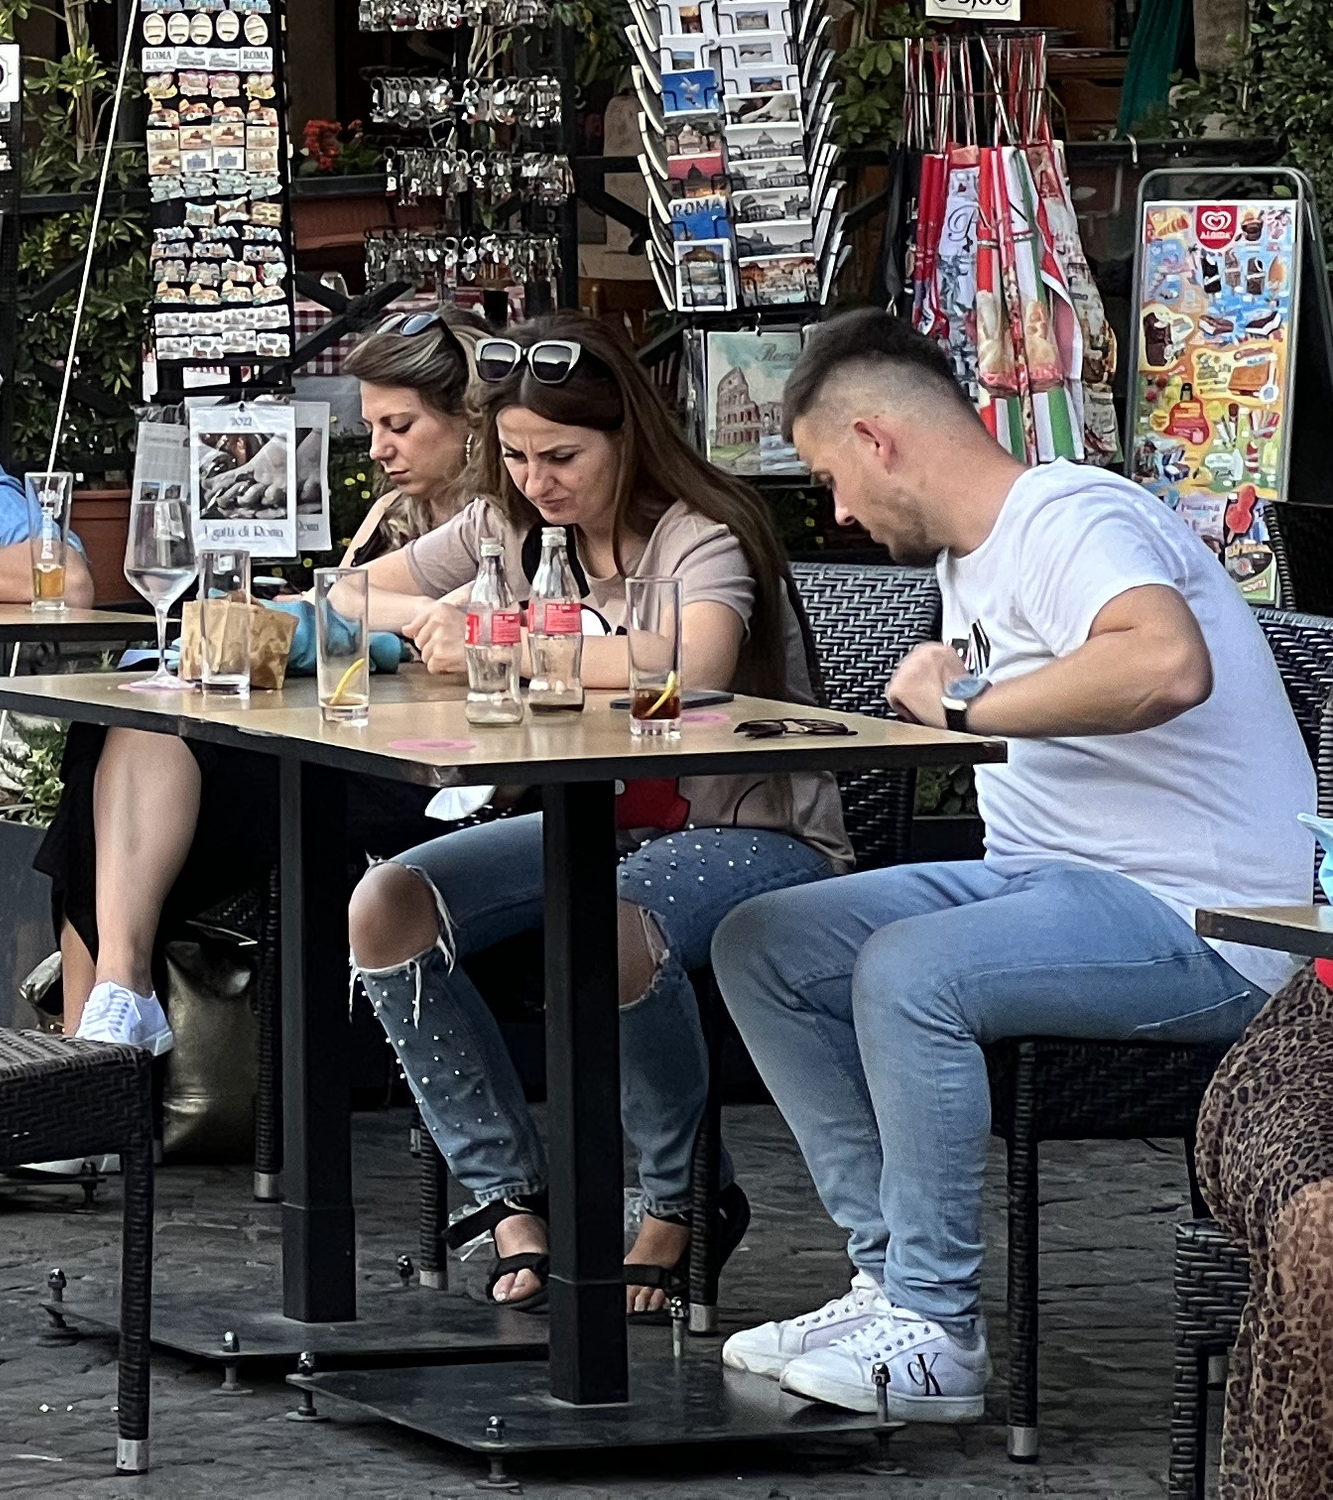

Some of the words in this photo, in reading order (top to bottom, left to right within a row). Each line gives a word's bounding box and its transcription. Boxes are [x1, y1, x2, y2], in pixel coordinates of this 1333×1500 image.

[145, 50, 172, 61] ROMA
[243, 49, 270, 61] ROMA
[239, 525, 250, 538] di
[254, 525, 284, 538] Roma
